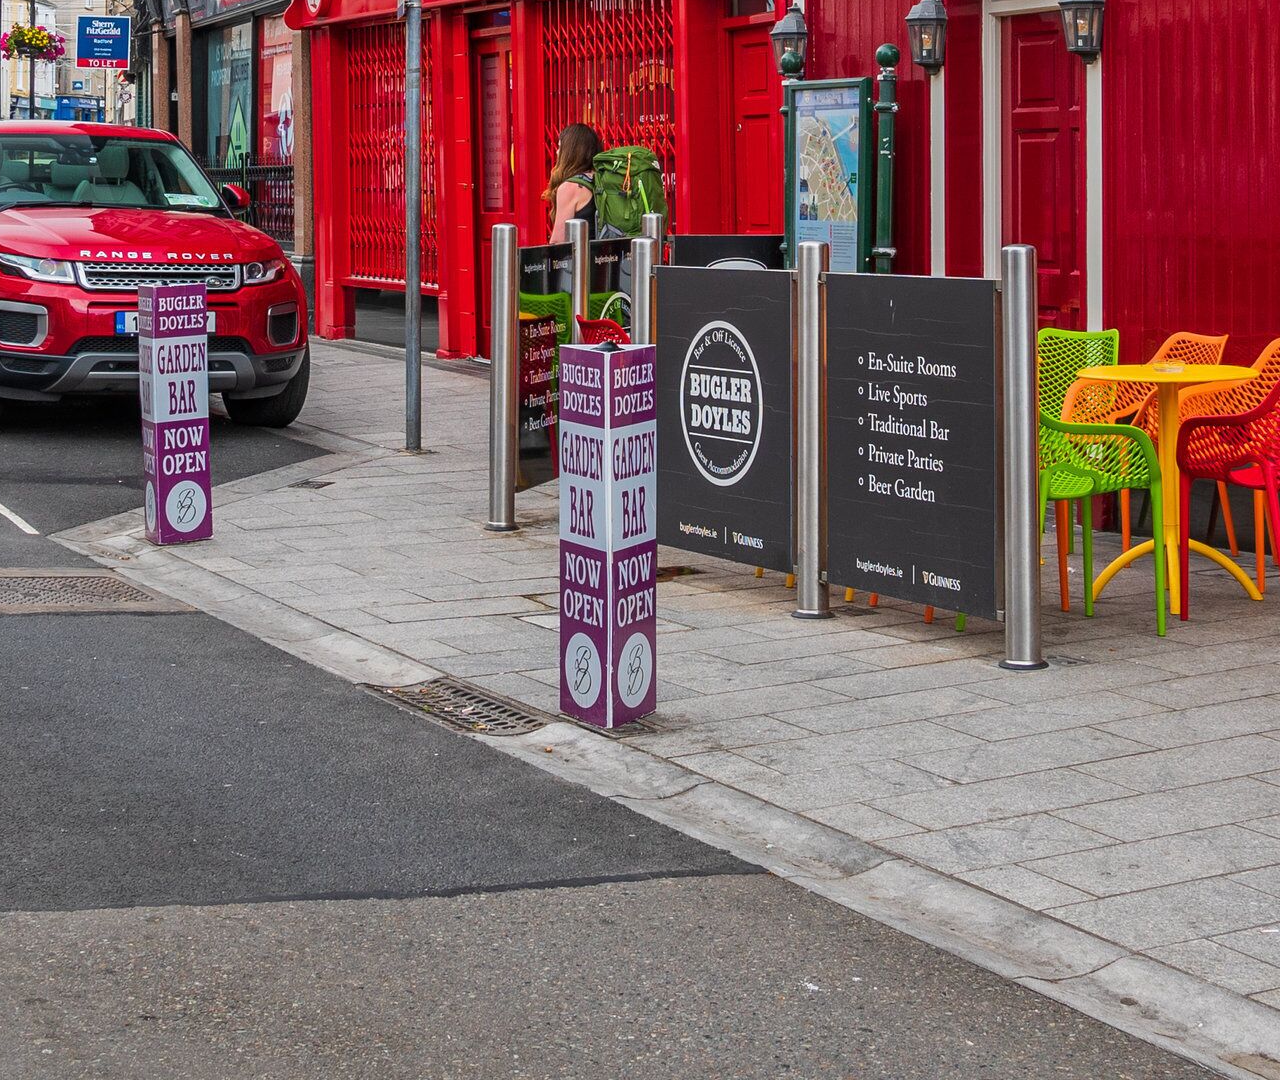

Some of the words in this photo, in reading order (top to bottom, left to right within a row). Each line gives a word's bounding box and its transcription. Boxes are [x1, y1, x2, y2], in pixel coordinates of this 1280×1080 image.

[86, 27, 120, 35] FitzGerald
[92, 20, 115, 28] Sherry
[80, 250, 152, 259] RANGE
[158, 294, 204, 312] BUGLER
[159, 314, 204, 331] DOYLES
[157, 342, 205, 375] GARDEN
[529, 348, 540, 362] Live
[694, 342, 704, 360] Bar
[712, 329, 725, 342] Off
[725, 331, 748, 363] Licence
[562, 362, 601, 389] BUGLER
[613, 363, 654, 390] BUGLER
[868, 352, 914, 375] En-Suite
[917, 356, 956, 378] Rooms
[168, 380, 197, 415] BAR
[529, 394, 546, 409] Private
[690, 372, 752, 404] BUGLER
[868, 383, 890, 402] Live
[893, 385, 927, 407] Sports
[563, 390, 601, 417] DOYLES
[614, 392, 654, 417] DOYLES
[529, 418, 540, 431] Beer
[540, 414, 558, 428] Garden
[691, 403, 751, 436] DOYLES
[868, 413, 926, 438] Traditional
[930, 421, 949, 441] Bar
[164, 426, 203, 449] NOW
[163, 451, 206, 475] OPEN
[562, 431, 603, 482] GARDEN
[612, 431, 655, 482] GARDEN
[694, 441, 707, 470] Guest
[707, 449, 749, 476] Accommodation
[868, 444, 904, 466] Private
[907, 449, 944, 472] Parties
[868, 474, 891, 496] Beer
[895, 479, 935, 502] Garden
[570, 485, 594, 539] BAR
[622, 485, 646, 539] BAR
[679, 521, 718, 540] buglerdoyles.ie
[737, 532, 764, 550] GUINNESS
[565, 550, 601, 589] NOW
[618, 551, 652, 589] NOW
[856, 558, 903, 578] buglerdoyles.ie
[929, 571, 961, 591] GUINNESS
[563, 590, 603, 628] OPEN
[617, 588, 654, 628] OPEN
